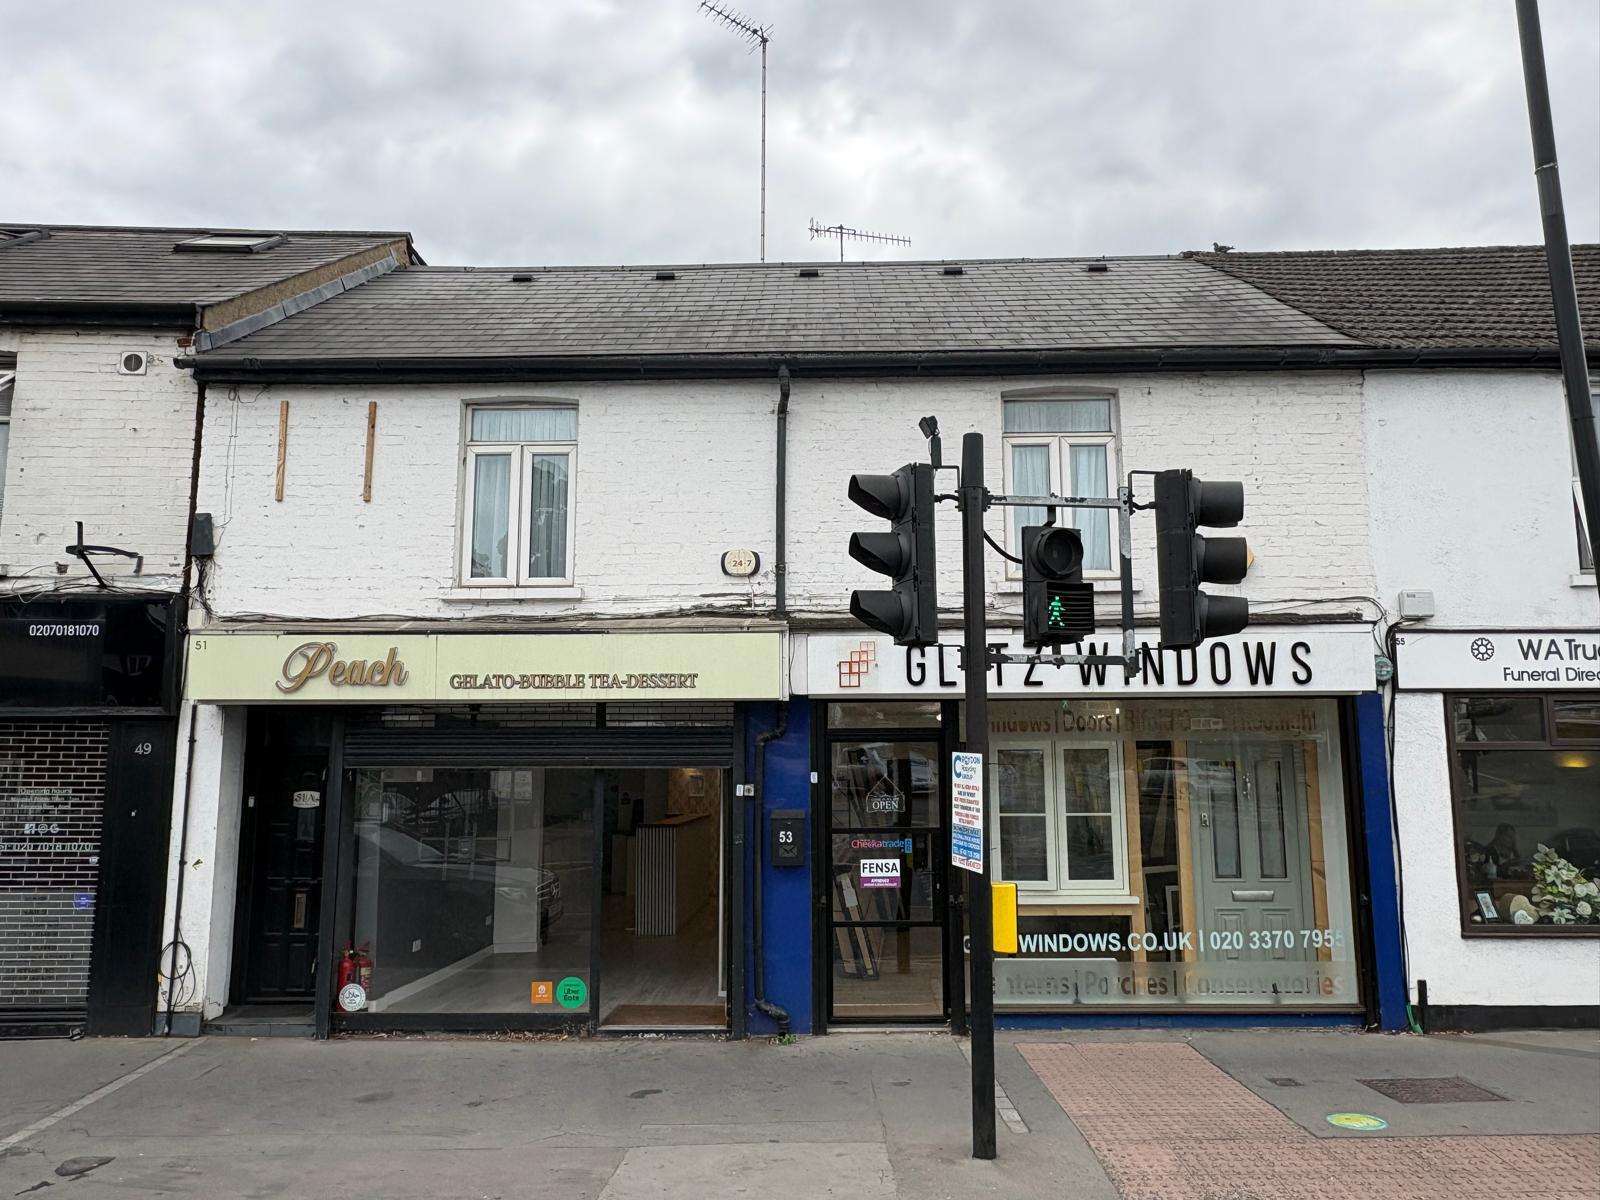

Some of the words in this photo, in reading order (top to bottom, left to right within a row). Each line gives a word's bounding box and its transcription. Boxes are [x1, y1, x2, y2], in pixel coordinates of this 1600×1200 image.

[29, 624, 99, 636] 02070181070
[195, 640, 207, 650] 51
[1564, 638, 1600, 661] Tru
[275, 641, 409, 694] Peach
[906, 642, 1044, 686] GLTZ
[1076, 641, 1313, 686] WNDOWS
[449, 673, 585, 690] GELATO-BUBBLE
[589, 673, 699, 690] TEA-DESSERT
[1503, 667, 1560, 682] Funeral
[1062, 709, 1112, 733] Doors
[134, 742, 152, 756] 49
[872, 800, 899, 810] OPEN
[779, 831, 793, 843] 53
[862, 862, 899, 874] FENSA
[1210, 931, 1243, 950] 020
[1249, 930, 1295, 949] 3370
